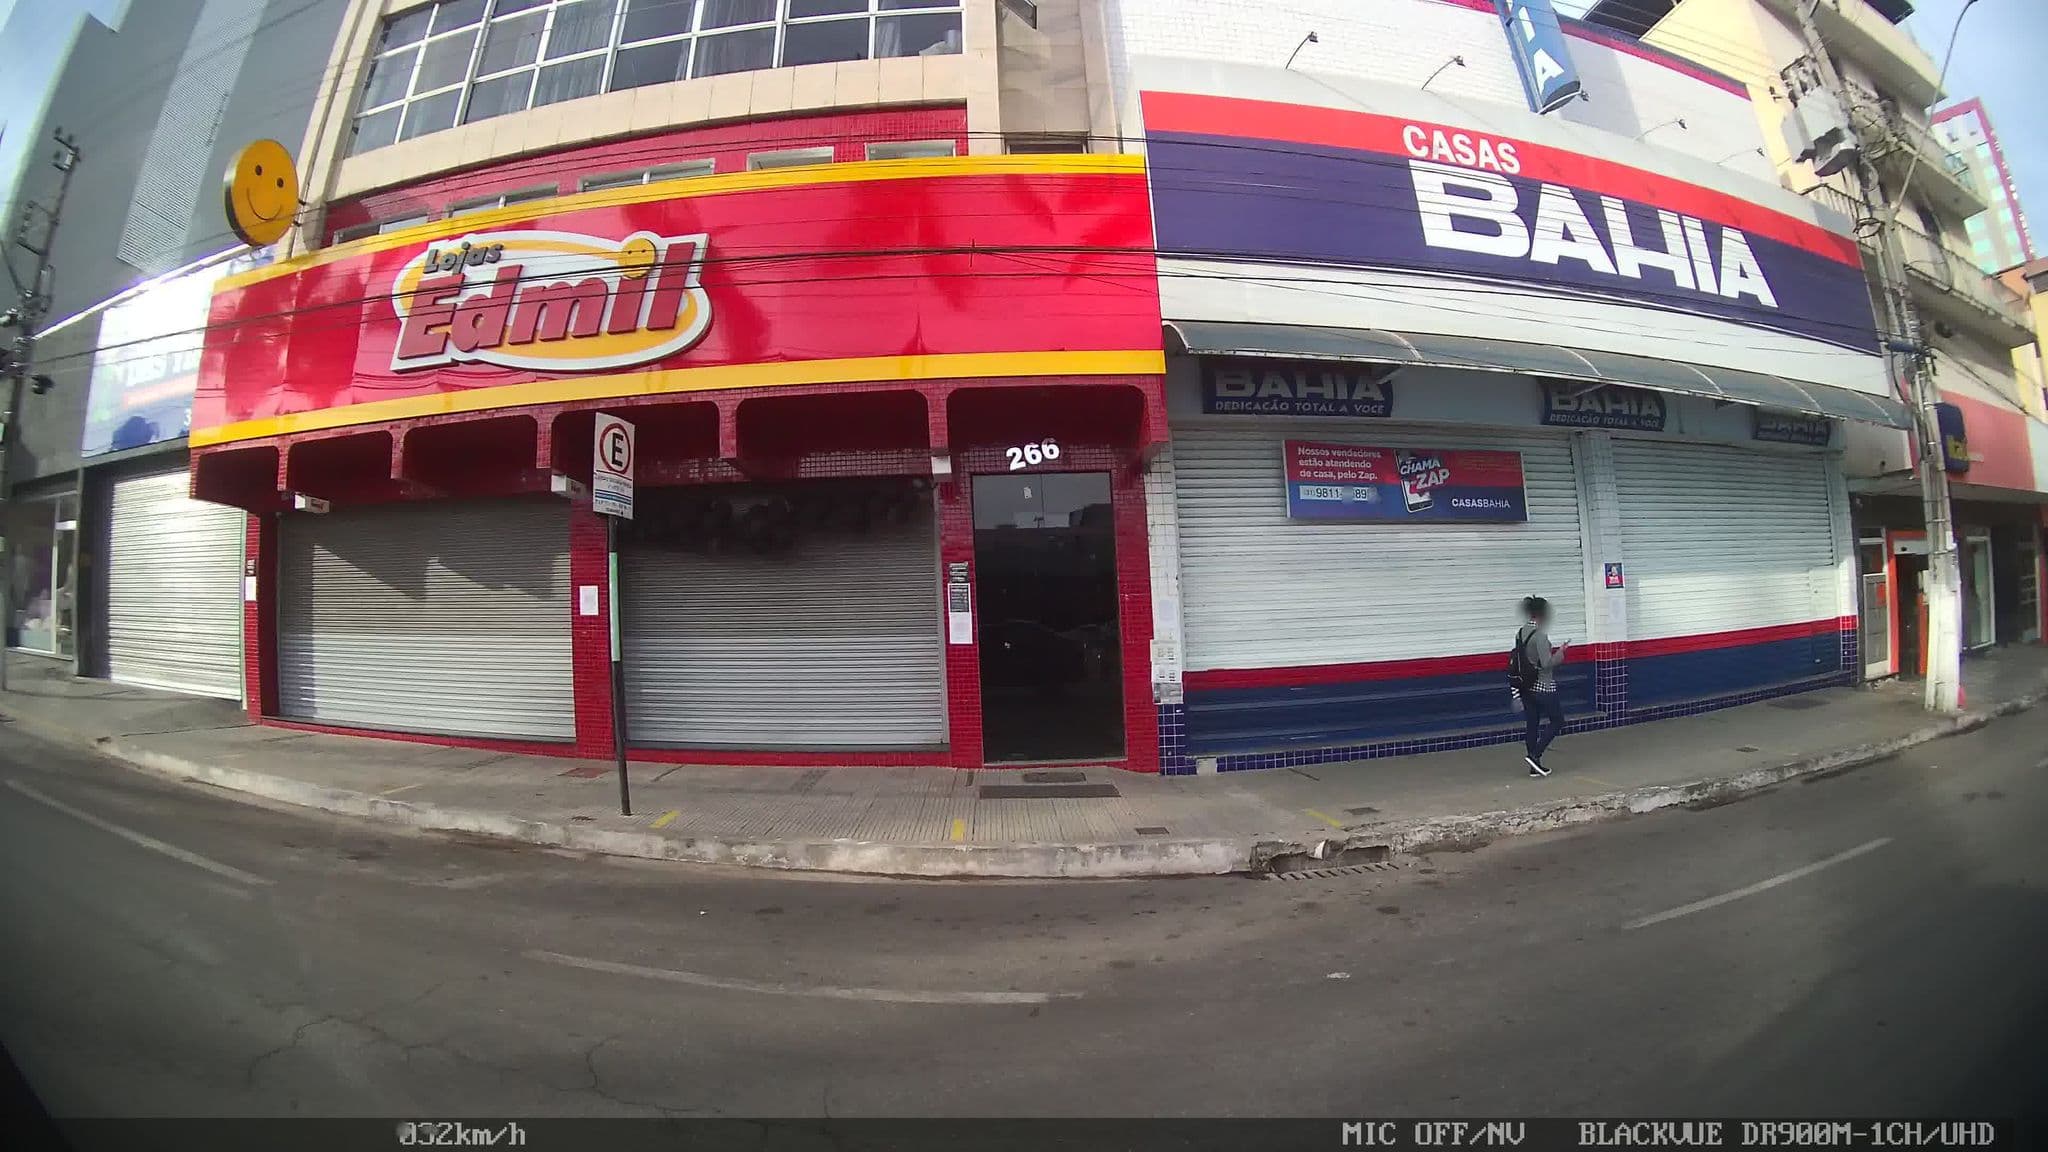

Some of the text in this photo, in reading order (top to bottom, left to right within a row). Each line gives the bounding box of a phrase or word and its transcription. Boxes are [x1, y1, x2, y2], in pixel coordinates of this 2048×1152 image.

[1402, 124, 1521, 175] CASAS
[1408, 158, 1779, 309] BAHIA
[423, 241, 504, 275] Lojas
[398, 241, 698, 360] Edmil
[1215, 370, 1386, 401] BAHIA
[1295, 402, 1336, 413] TOTAL
[611, 432, 624, 467] E
[1005, 439, 1060, 471] 266
[1297, 446, 1330, 456] Nossos
[1298, 457, 1372, 469] estão atendendo
[1299, 469, 1378, 481] de casa, pelo Zap.
[1400, 458, 1441, 475] CHAMA
[1416, 468, 1450, 490] ZAP
